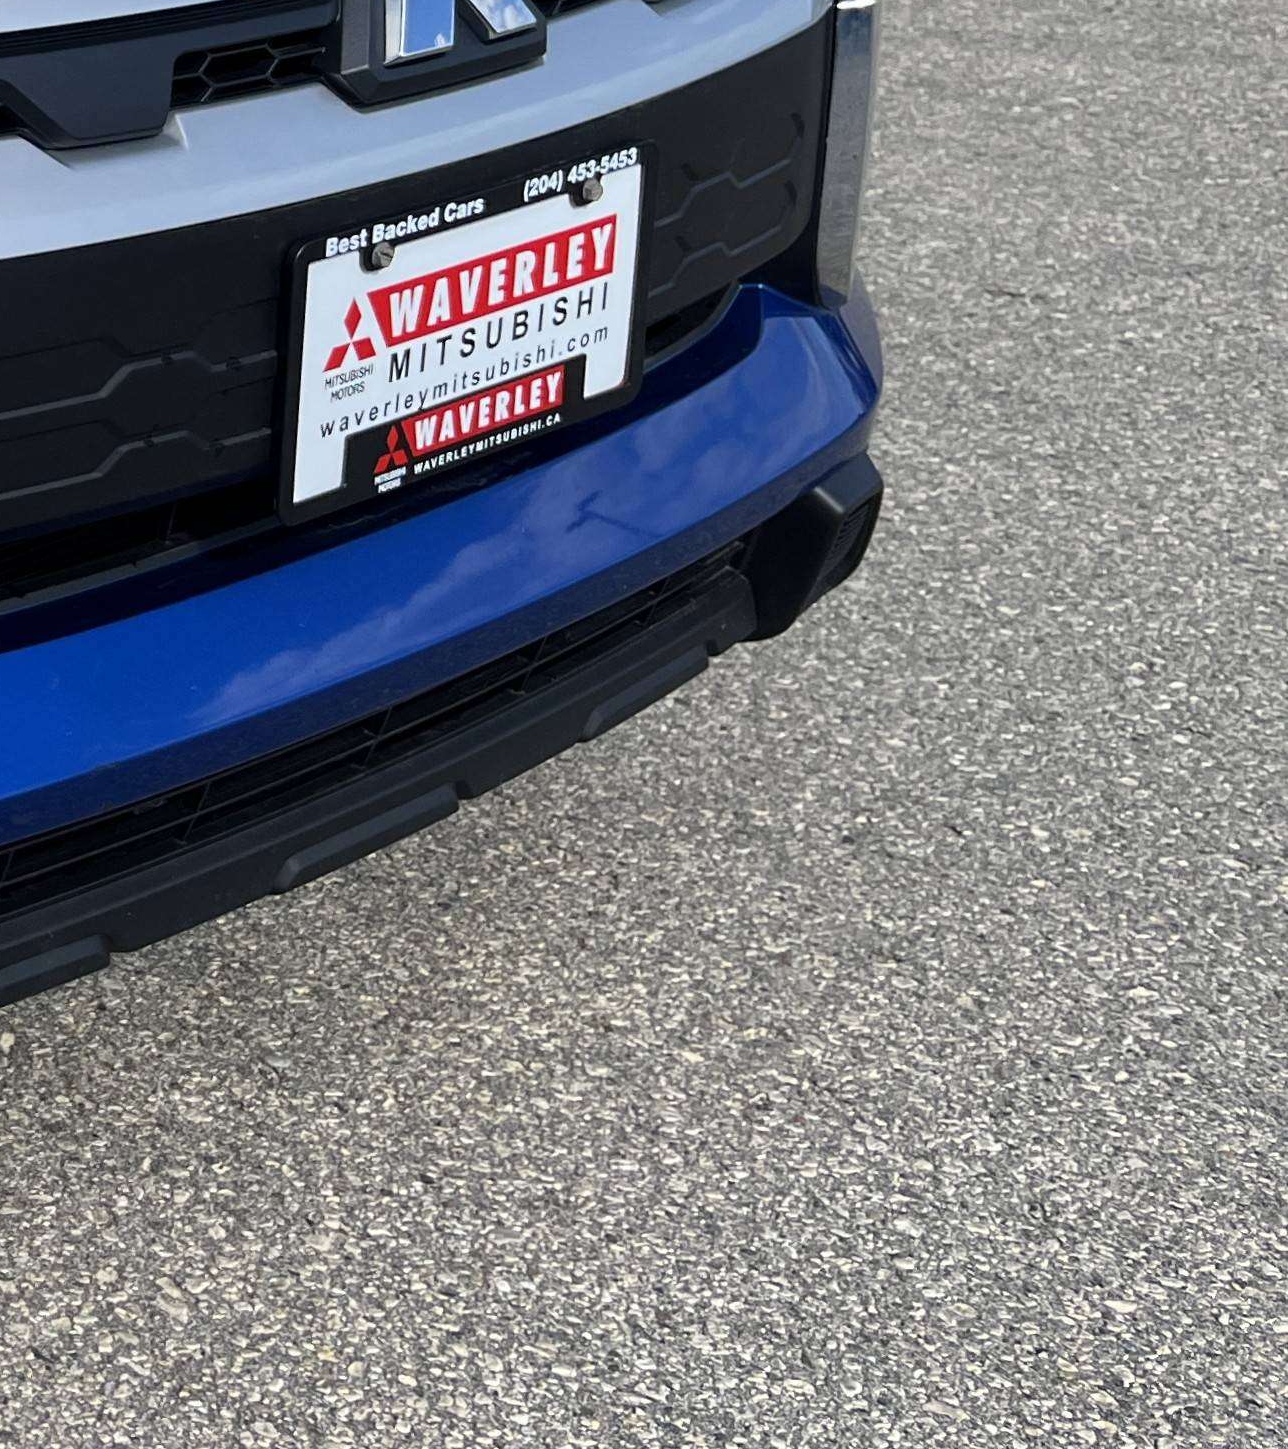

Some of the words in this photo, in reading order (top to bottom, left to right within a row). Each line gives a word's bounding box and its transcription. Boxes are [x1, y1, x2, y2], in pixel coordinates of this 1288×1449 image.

[523, 170, 563, 202] (204)
[566, 147, 638, 183] 453-5453
[325, 229, 368, 258] Best
[371, 207, 440, 244] Backed
[443, 197, 485, 223] Cars
[388, 223, 613, 339] WAVERLEY
[388, 282, 609, 383] MITSUBISHI
[320, 326, 609, 439] waverleymitsubishi.com
[325, 363, 374, 390] MITSUBISHI
[330, 381, 365, 402] MOTORS
[413, 369, 563, 452] WAVERLEY
[413, 413, 561, 475] WAVERLEYMITSUBISHI.CA
